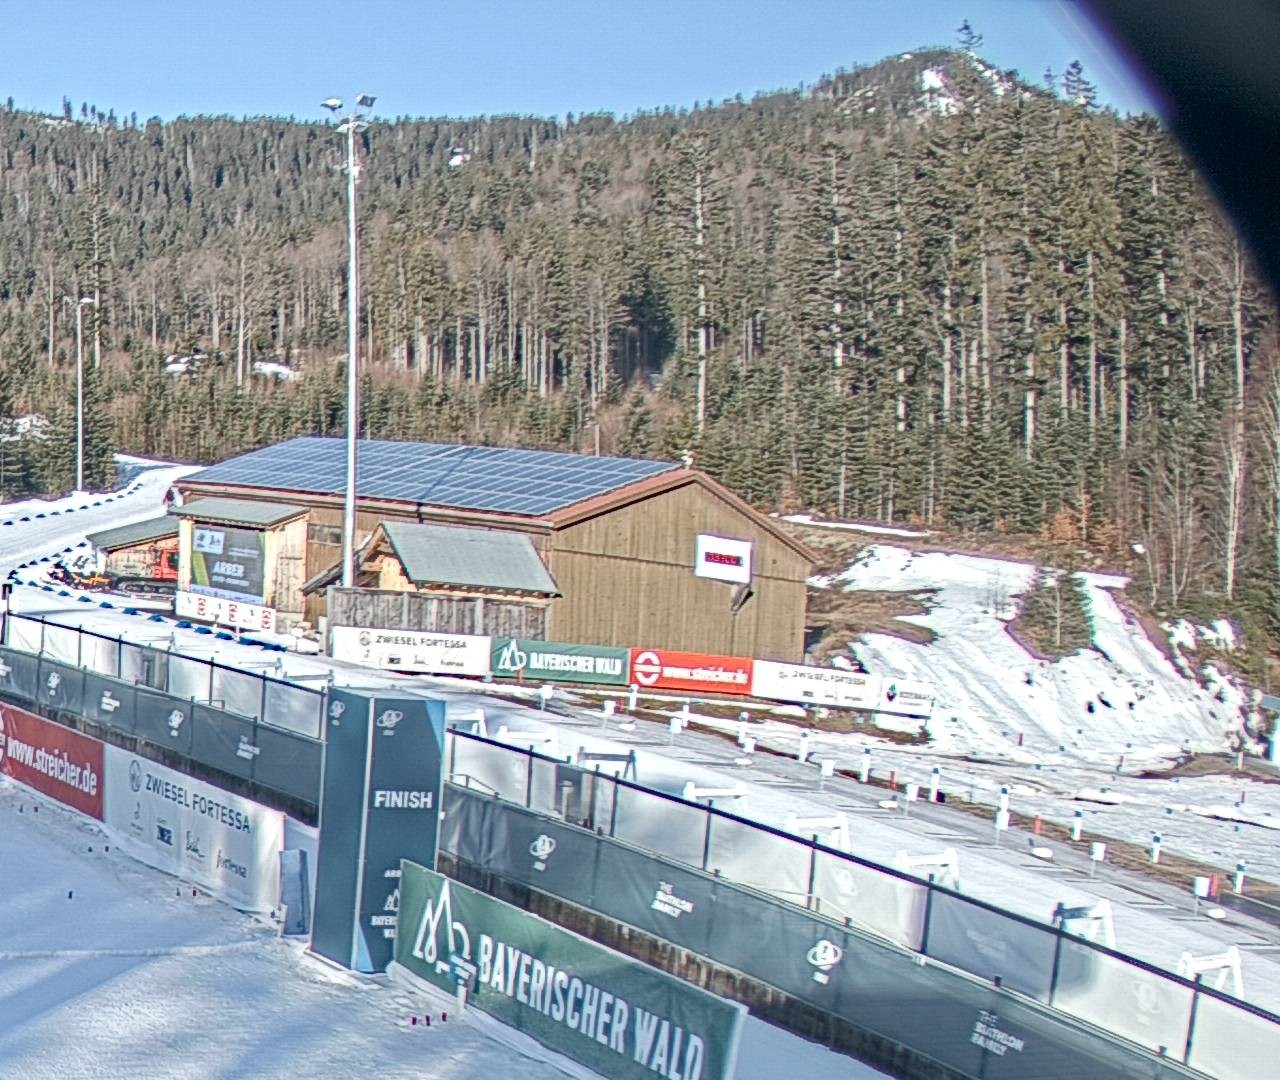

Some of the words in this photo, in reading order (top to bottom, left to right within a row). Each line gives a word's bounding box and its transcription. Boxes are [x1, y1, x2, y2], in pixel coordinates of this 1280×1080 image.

[7, 737, 97, 796] www.streicher.de
[145, 773, 191, 808] ZWIESEL
[192, 793, 252, 834] FORTESSA
[374, 789, 433, 809] FINISH
[478, 933, 630, 1056] BAYERISCHER
